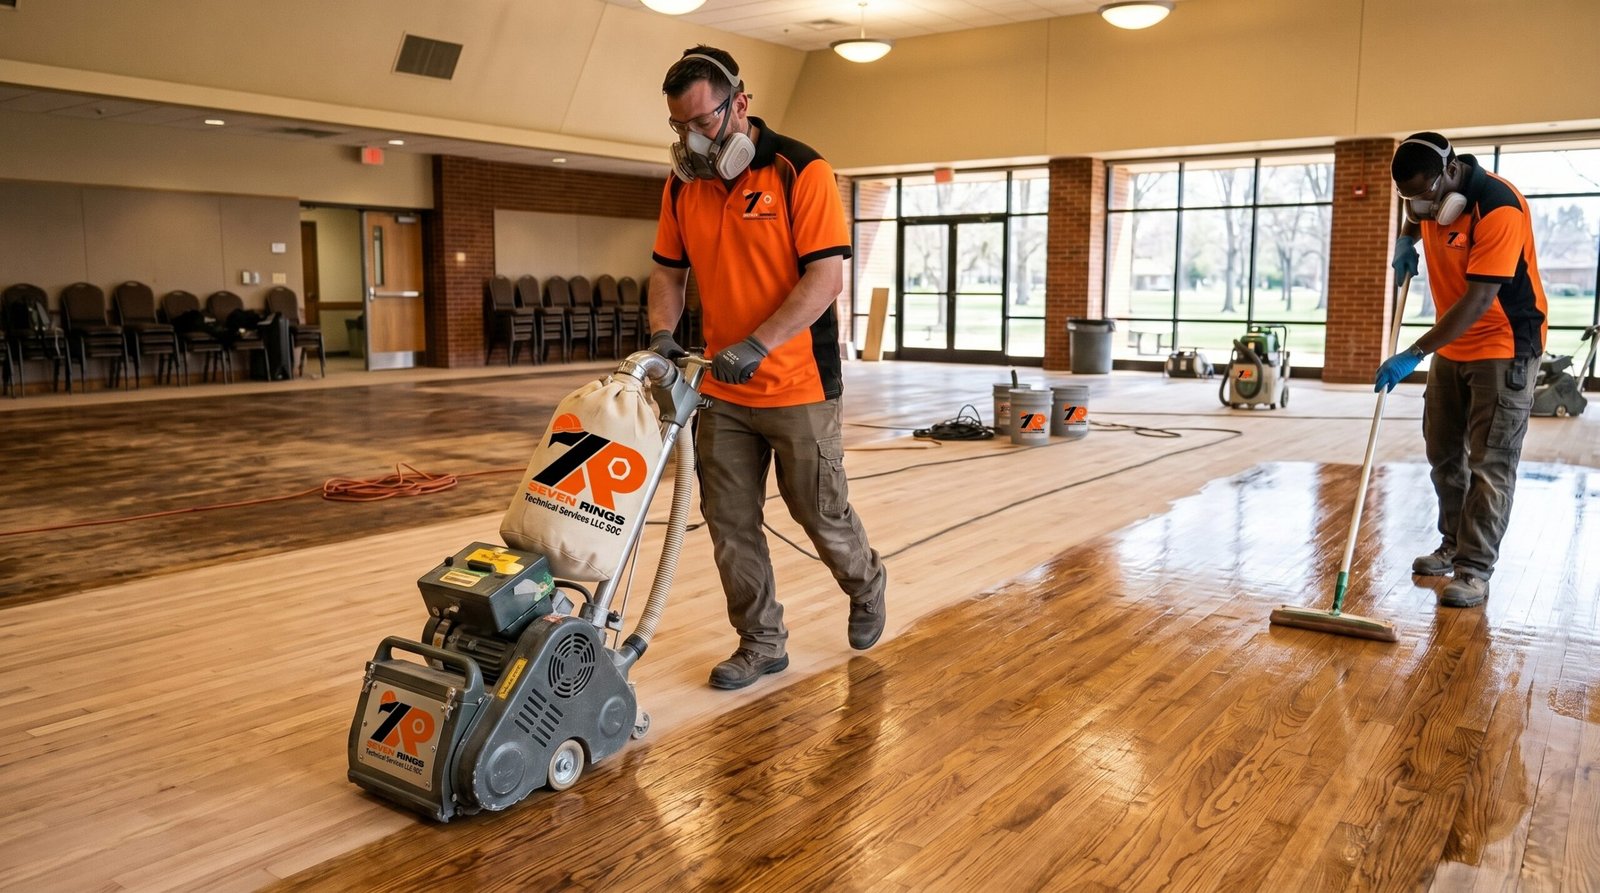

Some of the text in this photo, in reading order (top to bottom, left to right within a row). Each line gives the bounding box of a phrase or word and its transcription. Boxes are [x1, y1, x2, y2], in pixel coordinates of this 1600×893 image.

[525, 492, 622, 536] Technical Services LLC SOC
[527, 481, 626, 526] SEVEN RINGS
[366, 740, 425, 768] SEVEN RINGS
